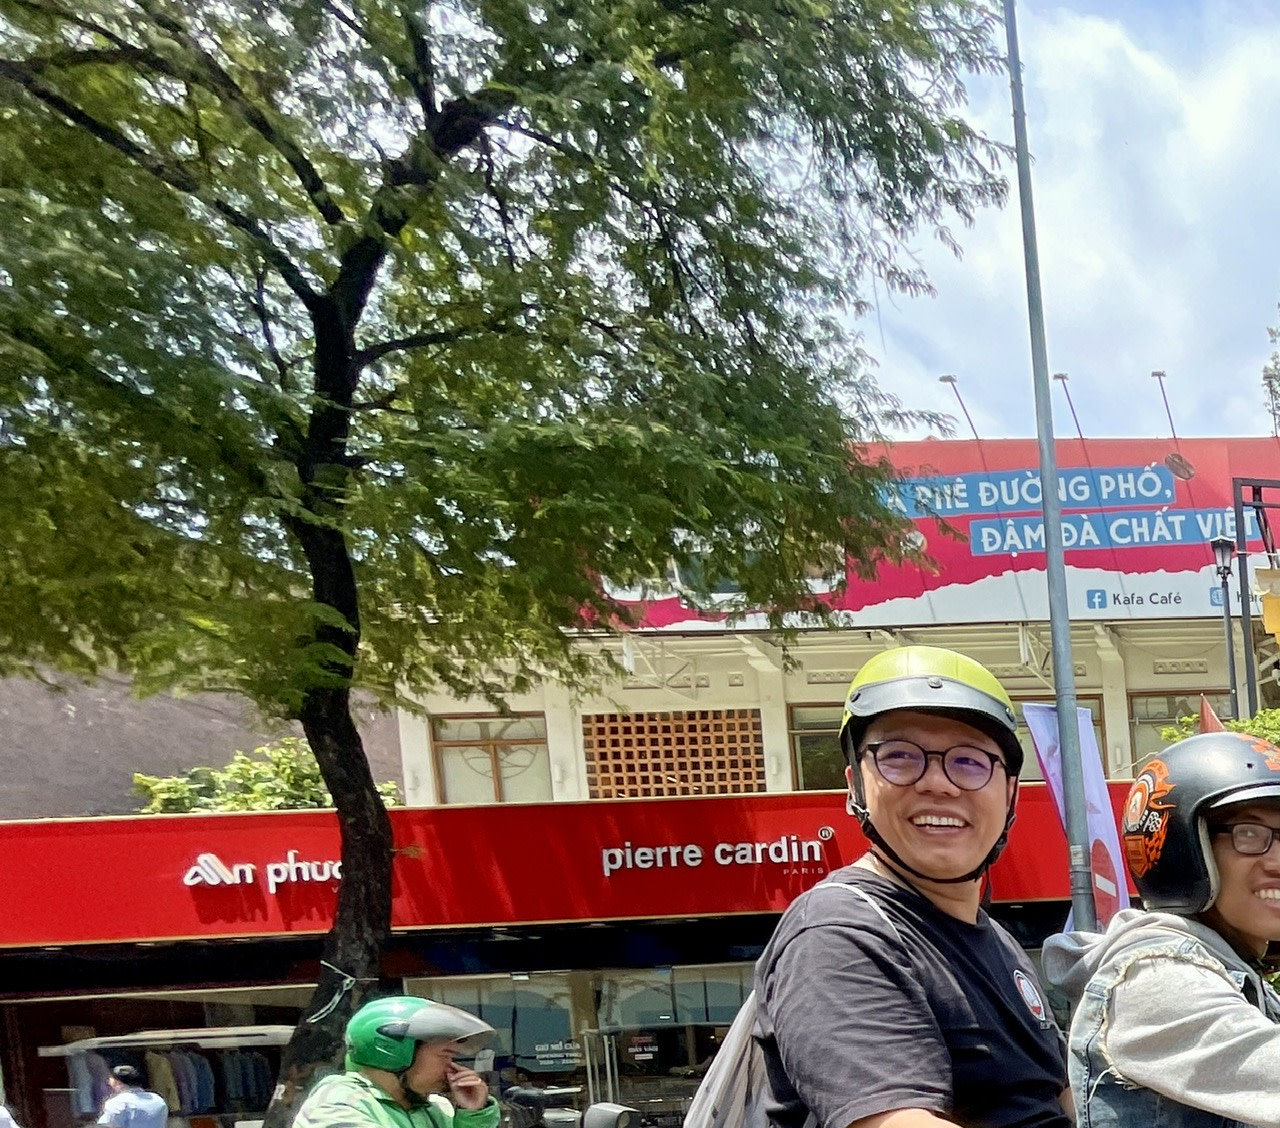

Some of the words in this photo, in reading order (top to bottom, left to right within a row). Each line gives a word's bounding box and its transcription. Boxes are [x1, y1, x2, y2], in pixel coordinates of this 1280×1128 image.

[1100, 462, 1172, 500] PHỐ,
[981, 519, 1046, 558] ĐẬM
[1060, 514, 1100, 547] ĐÀ
[1110, 506, 1186, 544] CHẤT
[1112, 593, 1144, 605] Kafa
[1149, 591, 1182, 605] Café
[602, 841, 703, 877] pierre
[714, 835, 822, 866] cardin
[783, 866, 824, 876] PARIS
